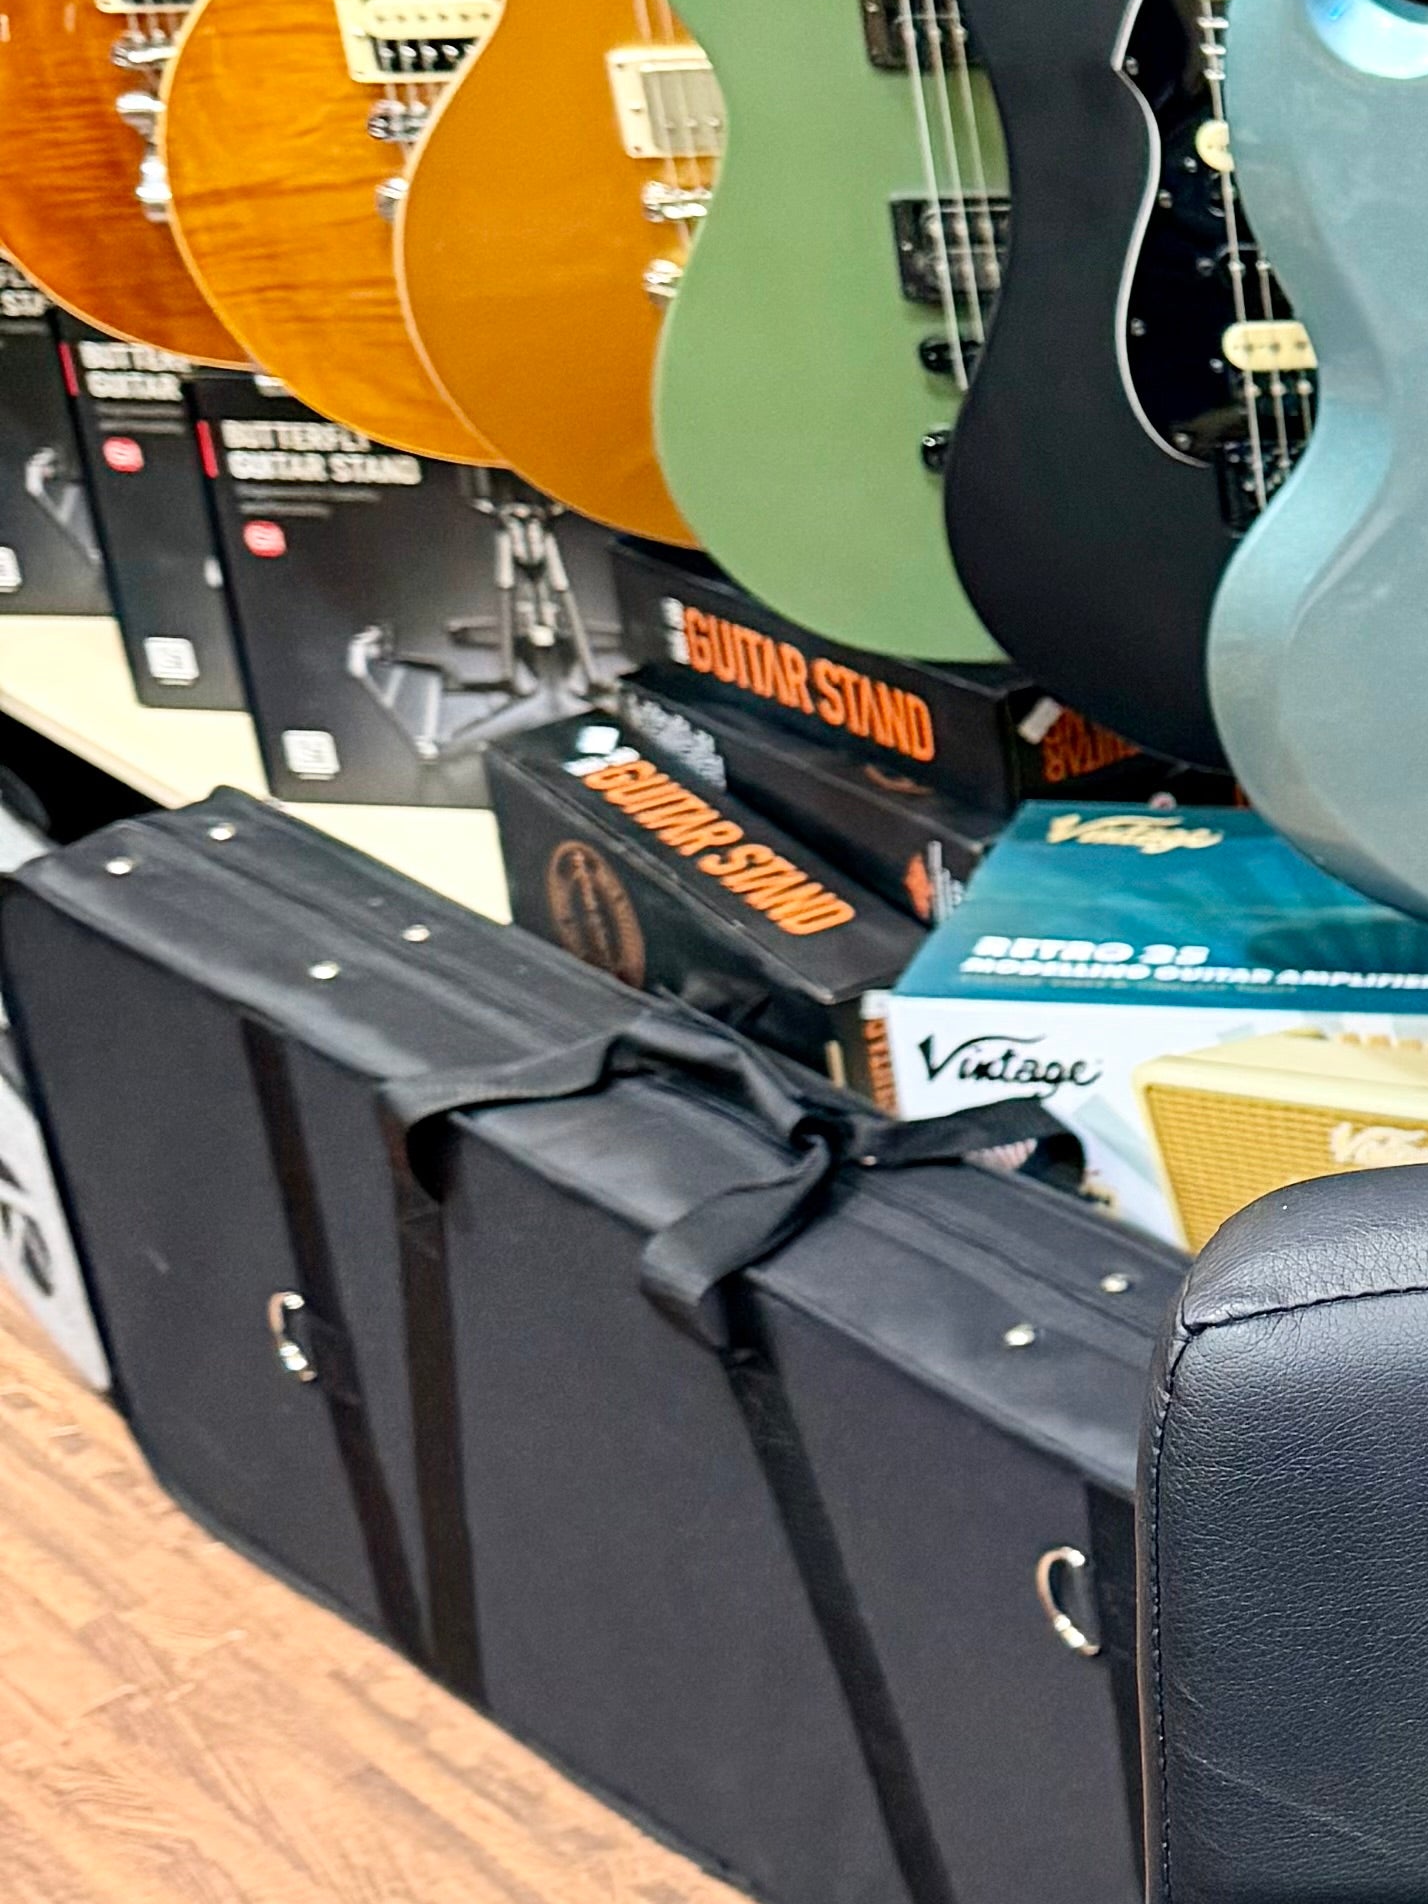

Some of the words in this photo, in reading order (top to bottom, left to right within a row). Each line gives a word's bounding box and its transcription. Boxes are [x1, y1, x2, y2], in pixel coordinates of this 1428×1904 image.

[226, 449, 329, 483] GUITAR
[329, 453, 423, 486] STAND
[684, 606, 814, 716] GUITAR
[810, 656, 936, 762] STAND
[585, 758, 744, 859] GUITAR
[697, 842, 857, 937] STAND
[1047, 813, 1224, 856] Vintage
[959, 956, 1152, 981] MODELLING
[1153, 963, 1275, 985] GUITAR
[973, 935, 1134, 964] RETRO
[918, 1034, 1104, 1100] Vintage
